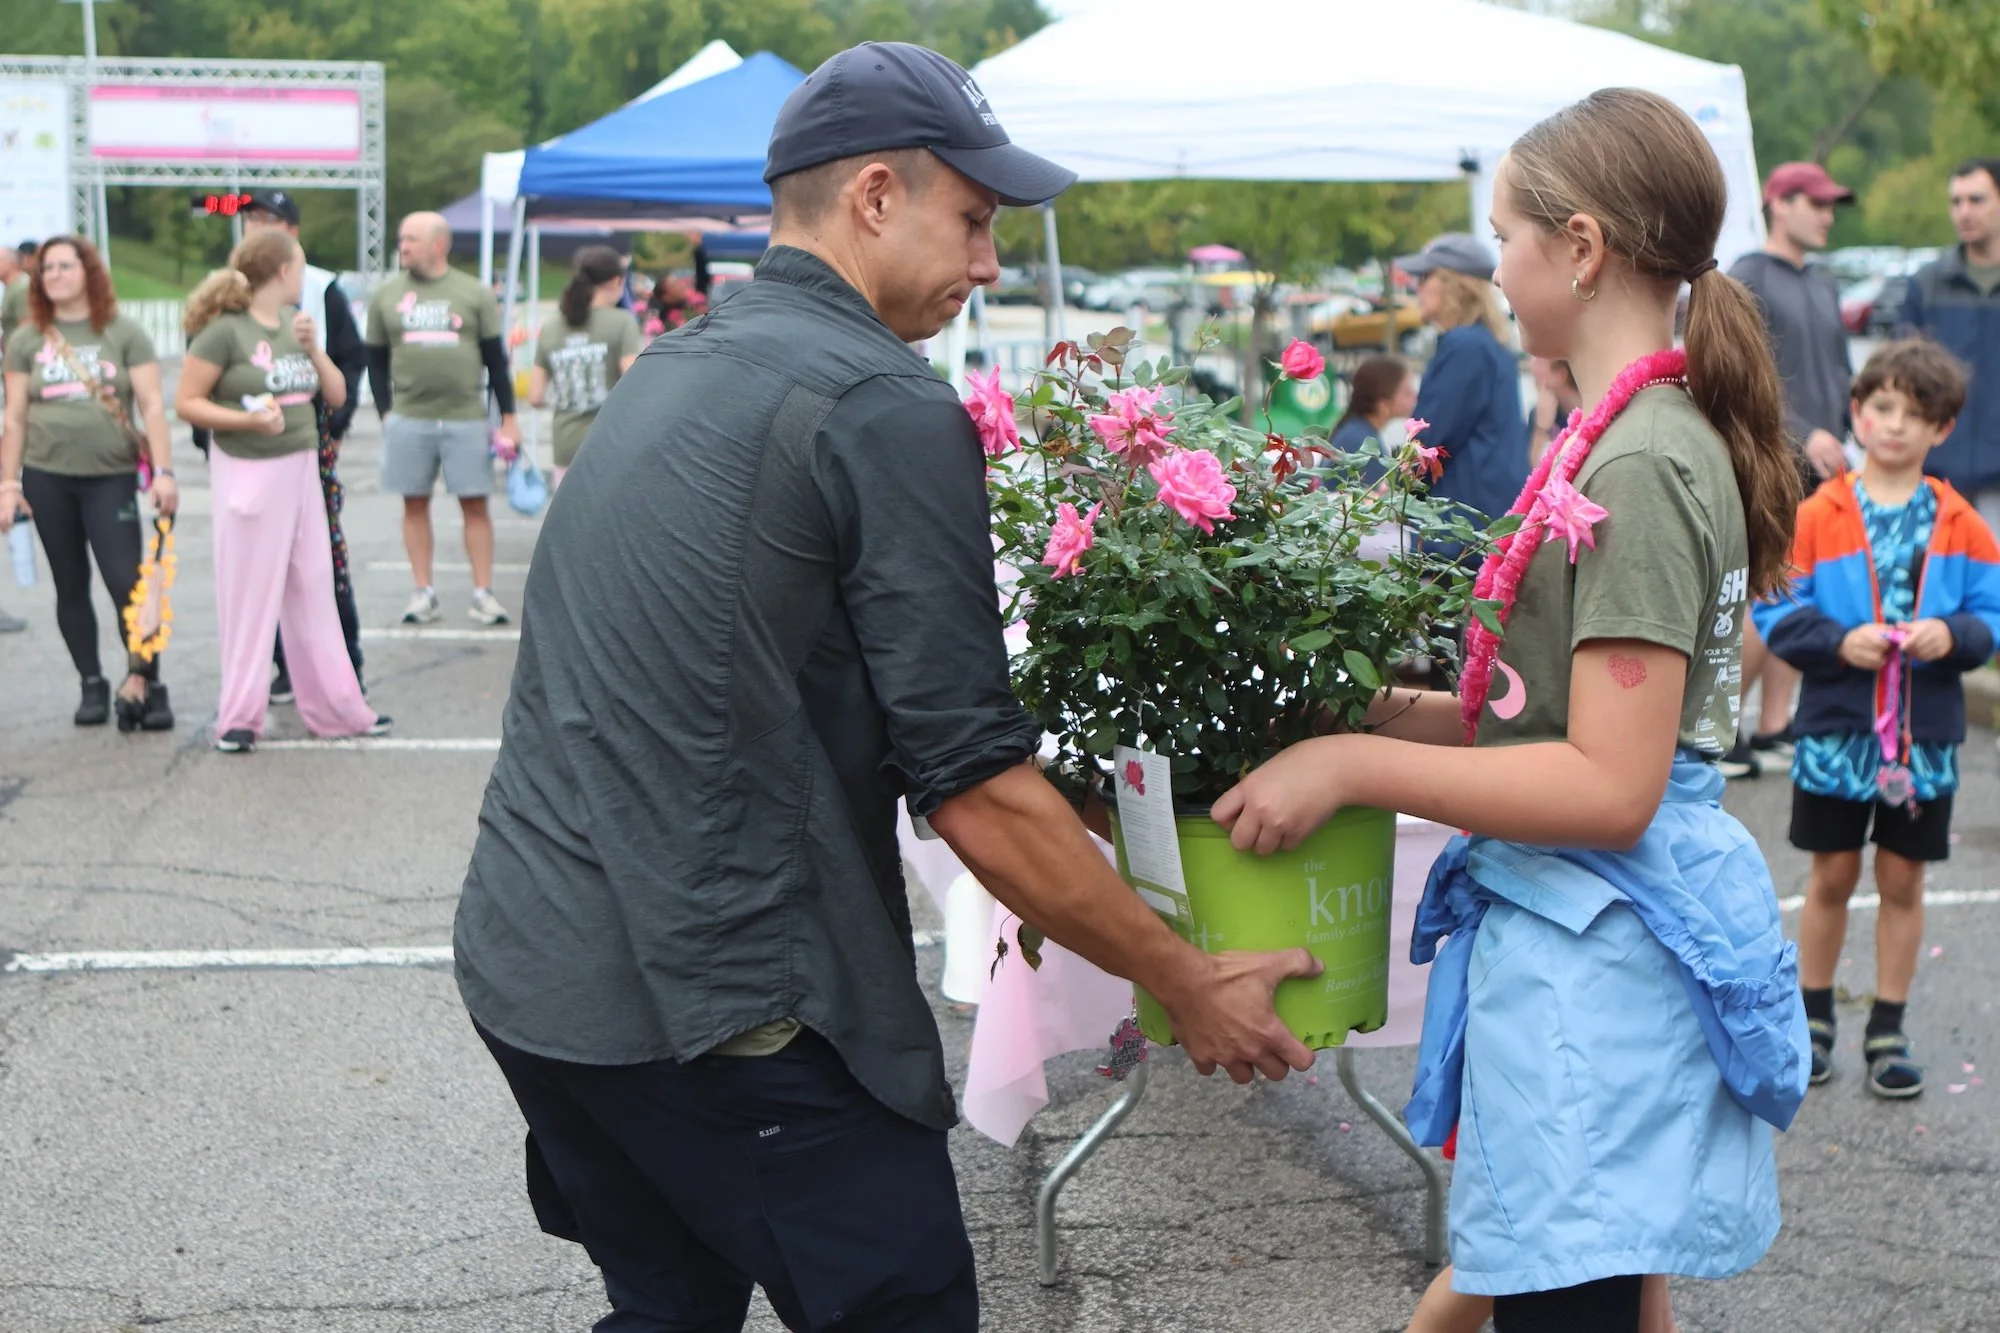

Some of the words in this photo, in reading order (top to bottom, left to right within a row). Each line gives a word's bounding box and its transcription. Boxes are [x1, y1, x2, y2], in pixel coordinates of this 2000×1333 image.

[1718, 567, 1747, 606] SH
[1304, 860, 1327, 872] the
[1306, 929, 1346, 944] family
[1348, 922, 1361, 936] of
